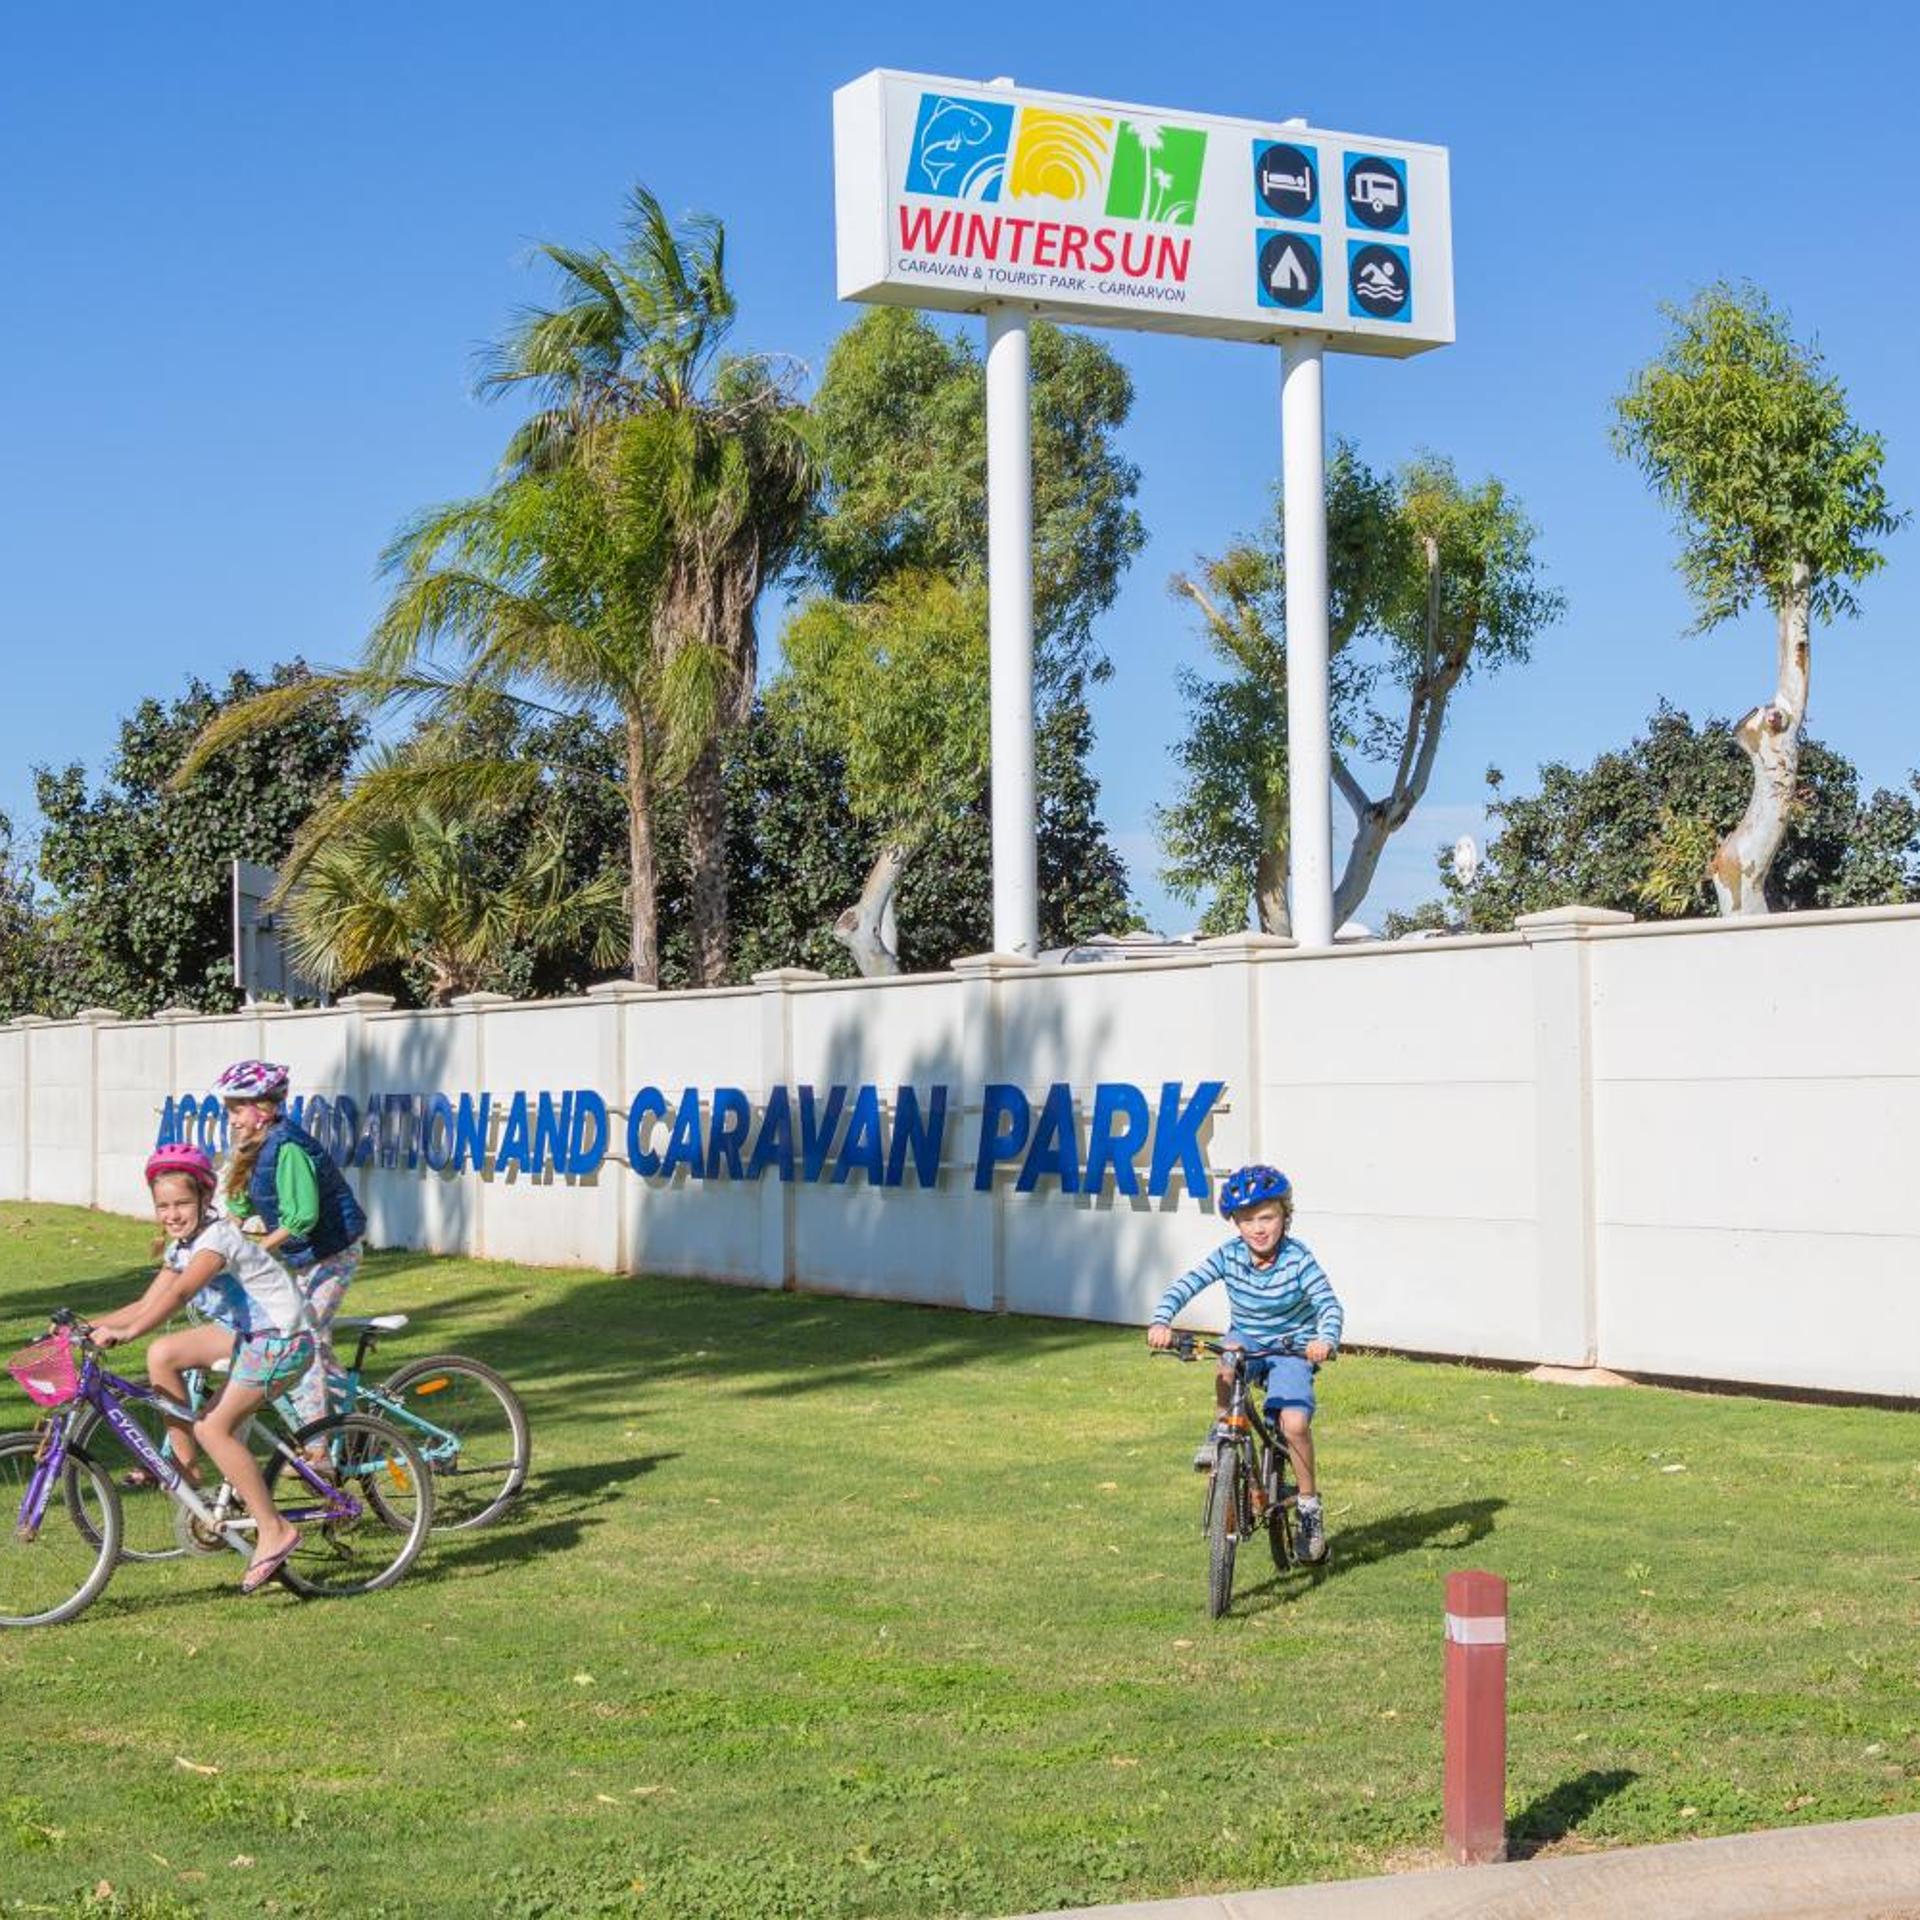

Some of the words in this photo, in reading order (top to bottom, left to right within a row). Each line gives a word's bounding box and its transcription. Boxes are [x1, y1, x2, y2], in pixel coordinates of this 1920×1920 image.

[898, 258, 969, 278] CARAVAN
[972, 267, 983, 280] &
[988, 268, 1047, 285] TOURIST
[1051, 275, 1085, 291] PARK
[1098, 281, 1186, 302] CARNARVON
[899, 205, 1191, 282] WINTERSUN
[495, 1089, 607, 1175] AND
[627, 1085, 947, 1187] CARAVAN
[974, 1082, 1225, 1198] PARK
